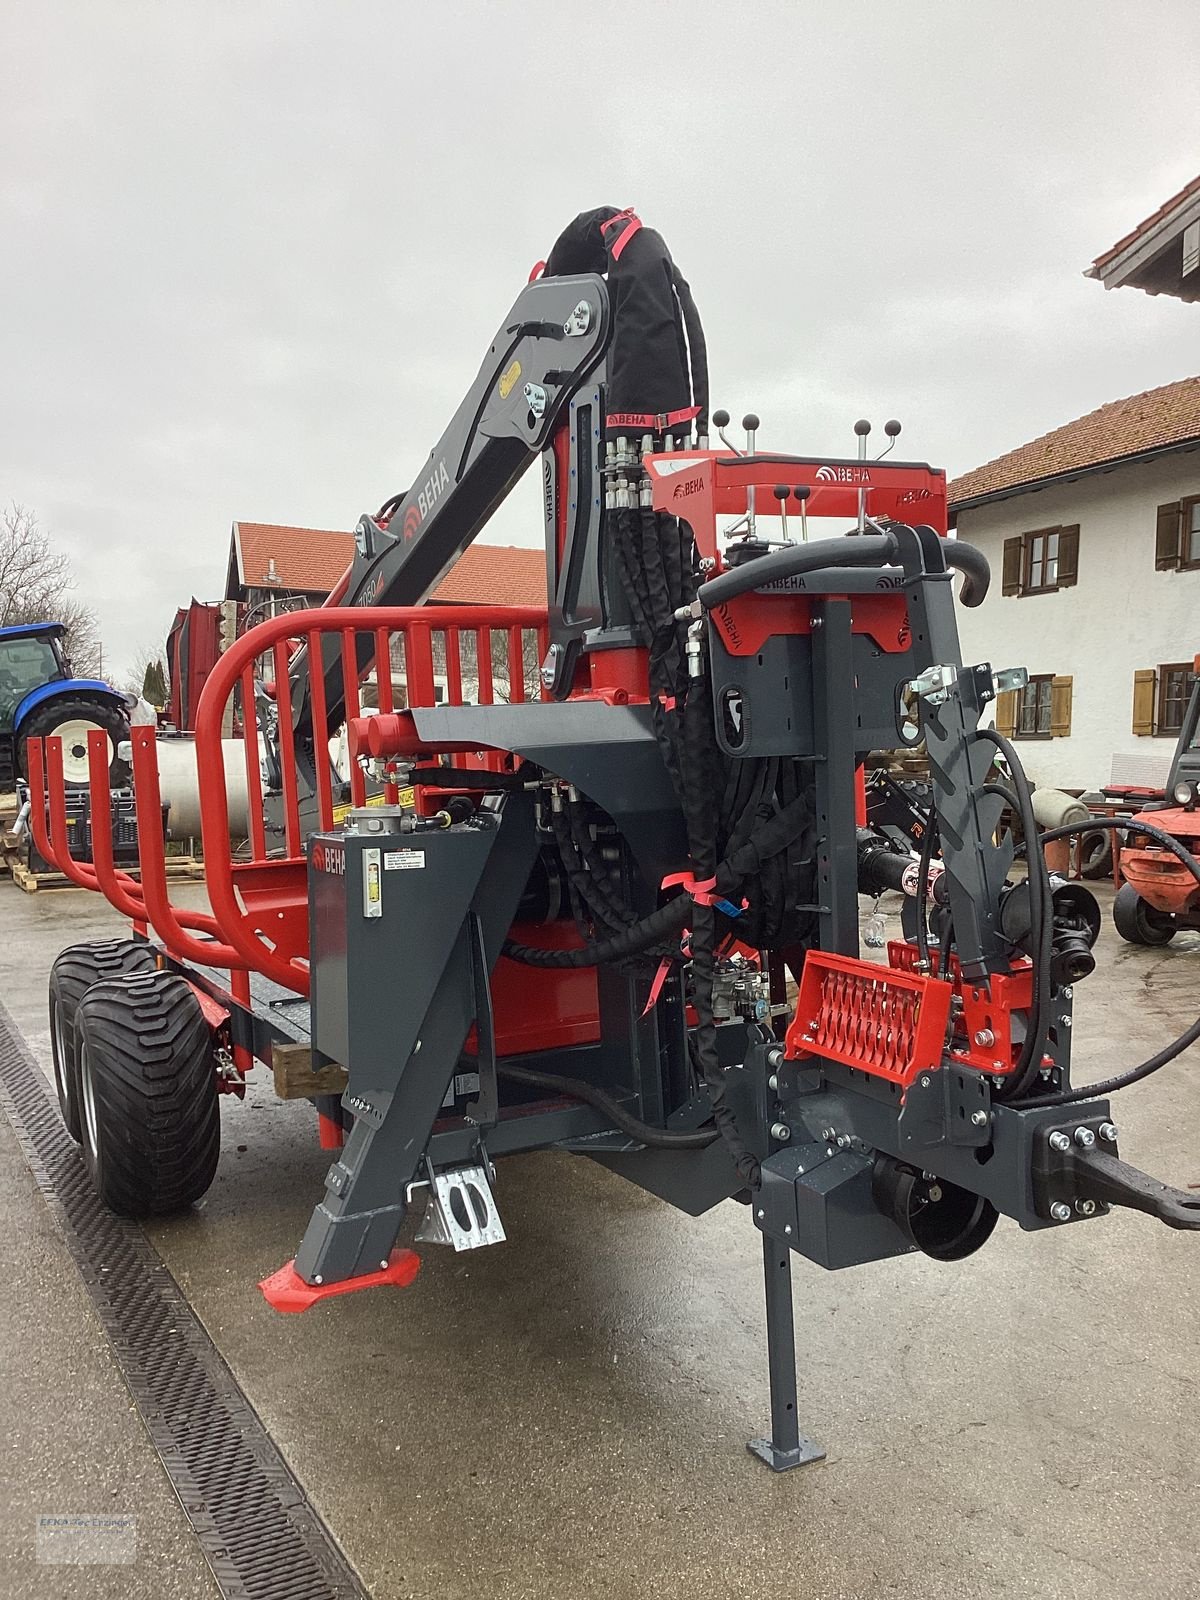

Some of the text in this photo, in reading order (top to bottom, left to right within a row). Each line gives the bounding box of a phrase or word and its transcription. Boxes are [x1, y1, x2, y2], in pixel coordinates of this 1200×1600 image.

[618, 414, 646, 425] BEHA
[685, 477, 705, 497] BEHA
[838, 467, 871, 482] BEHA
[418, 461, 450, 521] BEHA
[545, 484, 553, 522] BEHA
[724, 616, 743, 650] BEHA
[325, 847, 346, 875] BEHA
